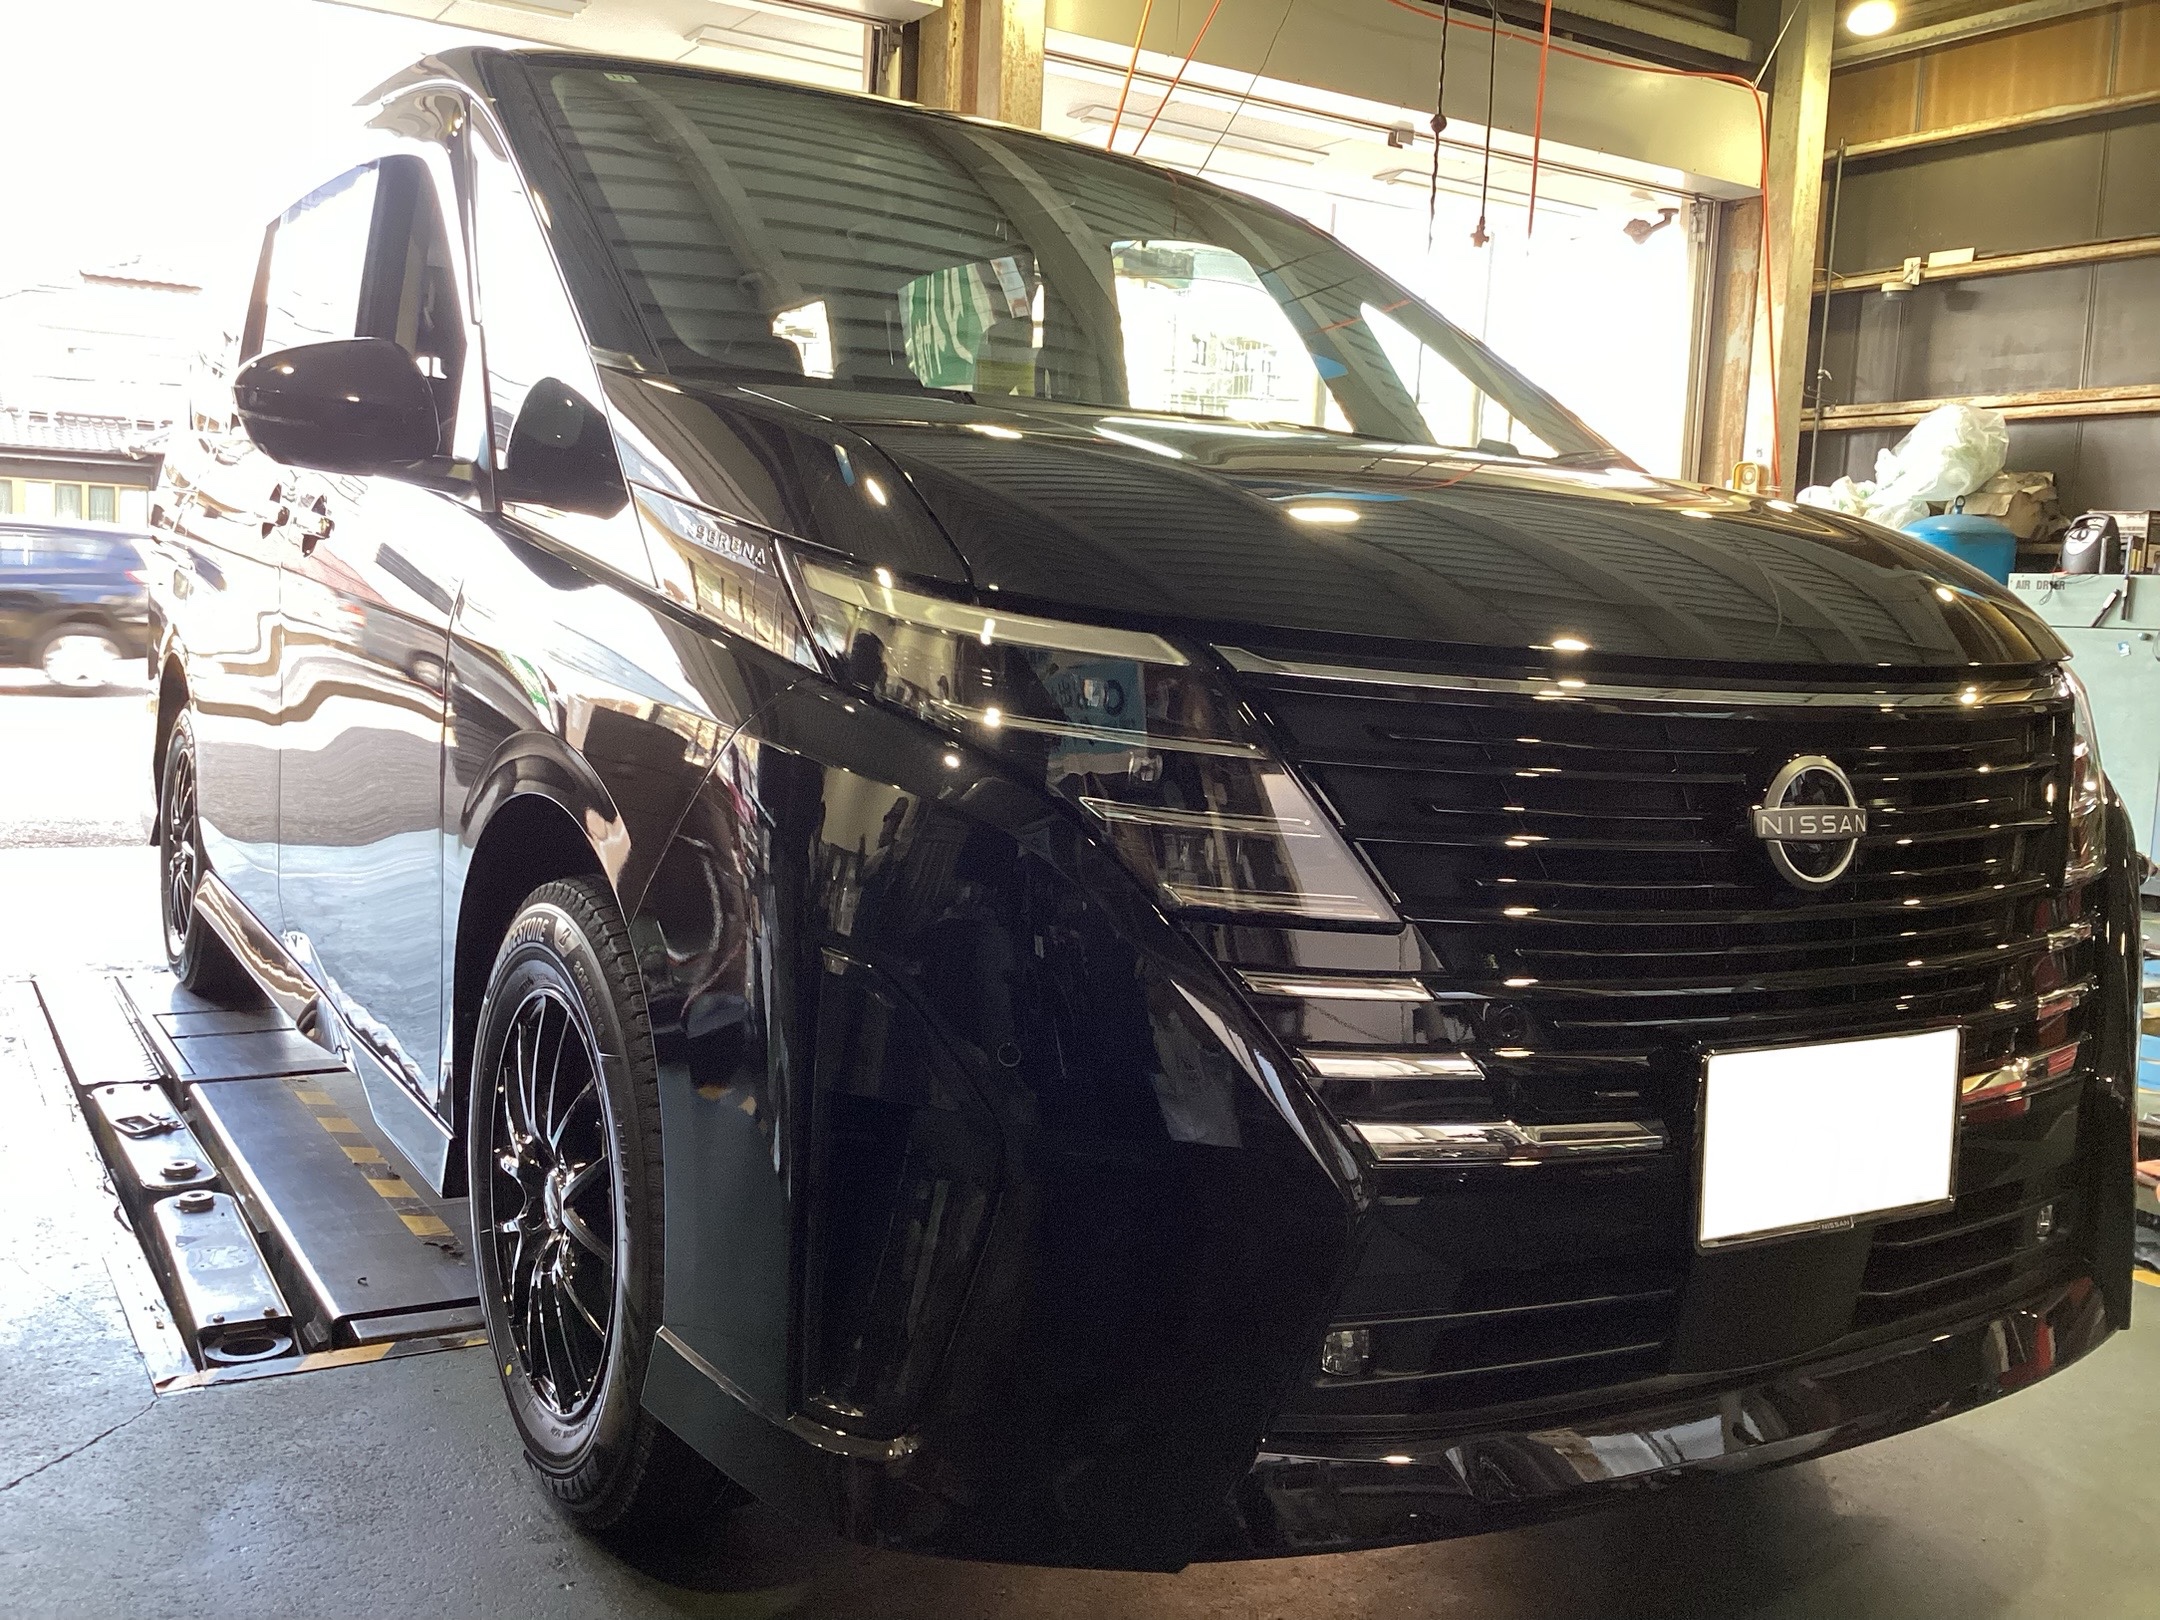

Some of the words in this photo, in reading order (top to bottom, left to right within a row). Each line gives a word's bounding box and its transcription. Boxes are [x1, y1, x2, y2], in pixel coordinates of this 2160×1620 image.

[696, 525, 766, 565] SERENA
[2015, 580, 2031, 590] AIR
[2036, 580, 2066, 590] DRER
[1761, 814, 1867, 835] NISSAN
[489, 916, 550, 989] IDGESTONE
[1821, 1220, 1850, 1230] NISSAN
